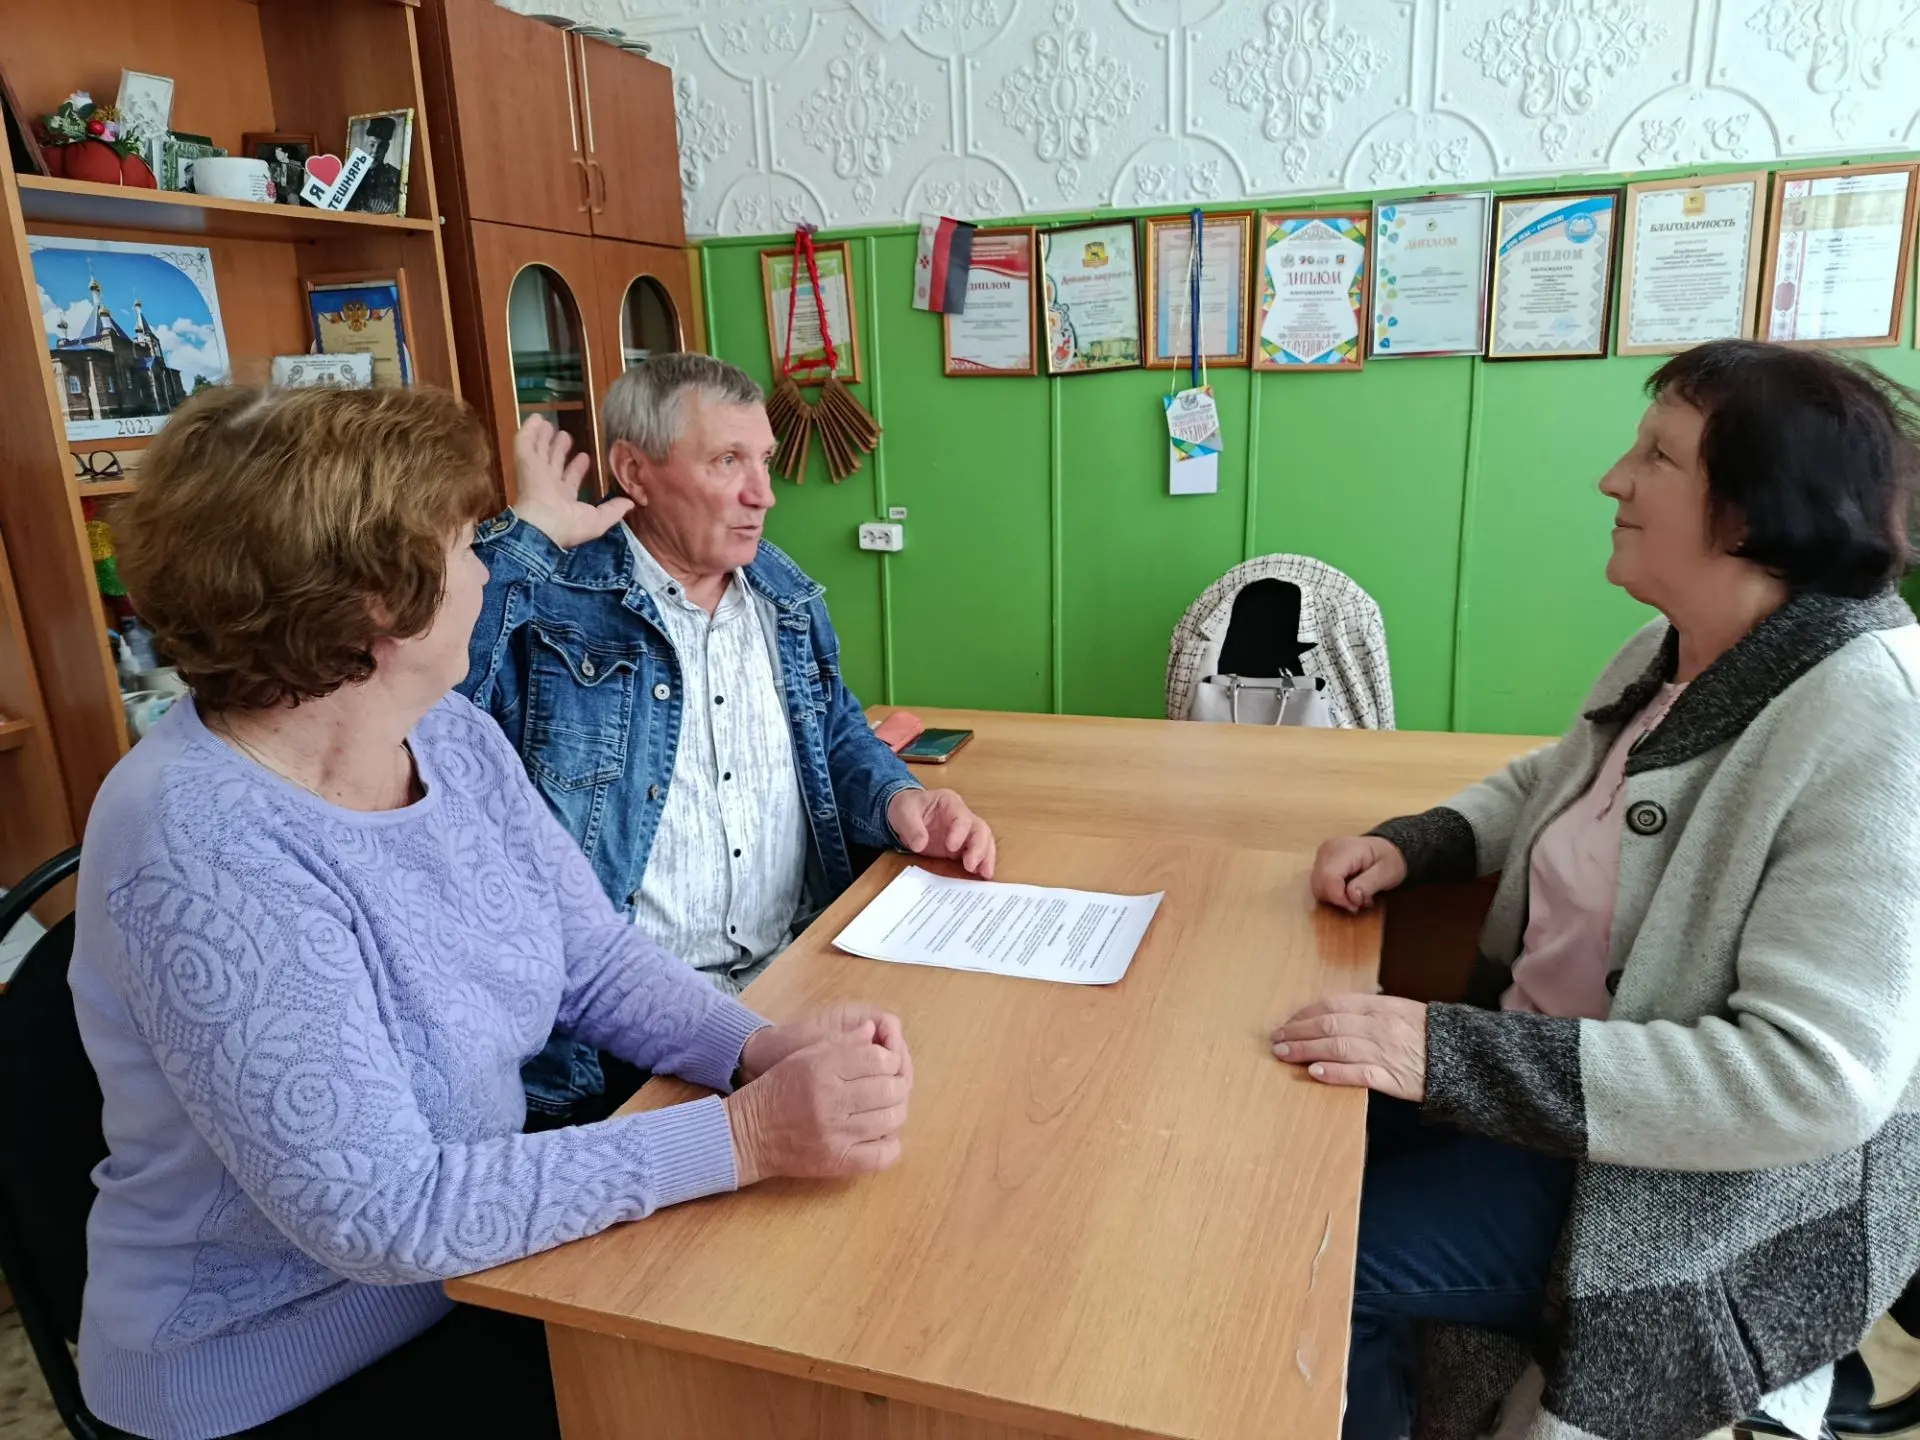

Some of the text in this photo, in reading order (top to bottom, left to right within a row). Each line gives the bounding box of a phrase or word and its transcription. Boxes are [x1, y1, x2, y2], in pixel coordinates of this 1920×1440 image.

[328, 154, 367, 210] ТЕШНЯРЬ
[309, 183, 326, 202] Я
[1650, 218, 1736, 233] БЛАГОДАРНОСТЬ
[1405, 237, 1458, 250] ДИПЛОМ
[1522, 249, 1583, 264] ДИПЛОМ
[967, 281, 1011, 292] ДИПЛОМ
[1284, 271, 1342, 287] ДИПЛОМ
[114, 418, 154, 435] 2023
